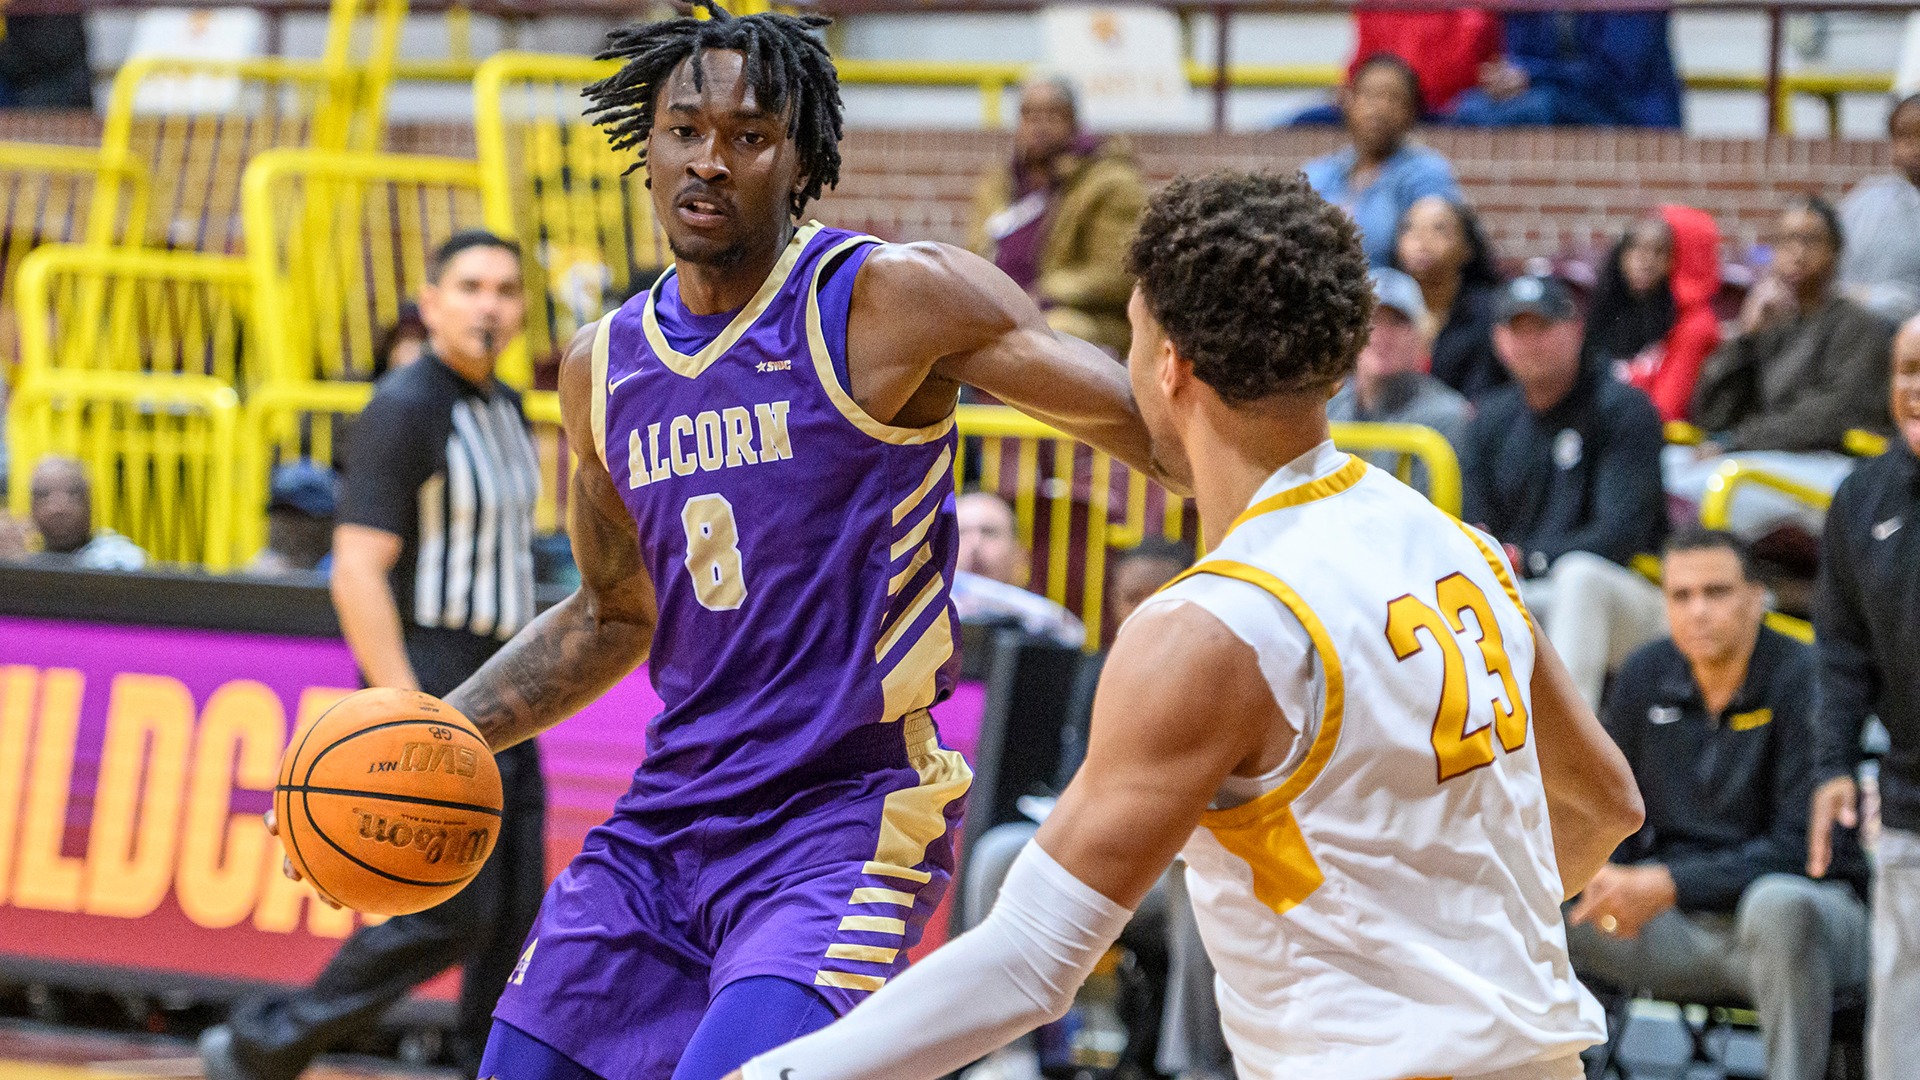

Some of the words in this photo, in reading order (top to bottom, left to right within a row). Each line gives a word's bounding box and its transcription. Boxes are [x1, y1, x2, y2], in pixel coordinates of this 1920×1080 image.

[628, 400, 793, 490] ALCORN
[681, 492, 748, 611] 8
[1384, 571, 1528, 784] 23
[367, 761, 397, 774] NXT
[399, 742, 478, 779] EVO
[357, 811, 489, 865] Wilson
